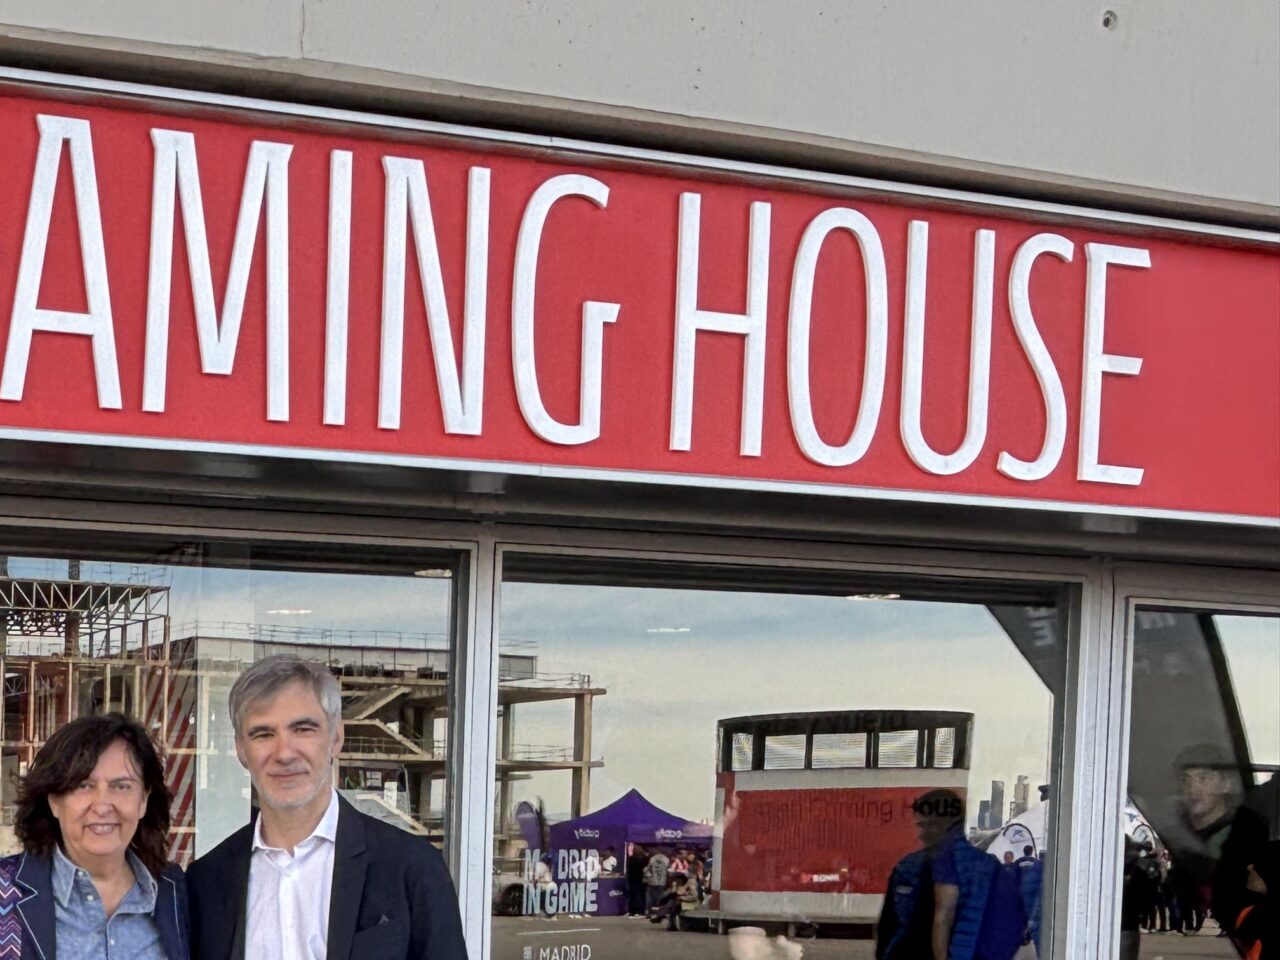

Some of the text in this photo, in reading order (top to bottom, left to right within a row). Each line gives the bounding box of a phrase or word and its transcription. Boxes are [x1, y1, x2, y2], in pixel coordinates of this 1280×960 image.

[669, 192, 1152, 485] HOUSE
[525, 849, 599, 879] MDRID
[523, 882, 598, 914] IN GAME
